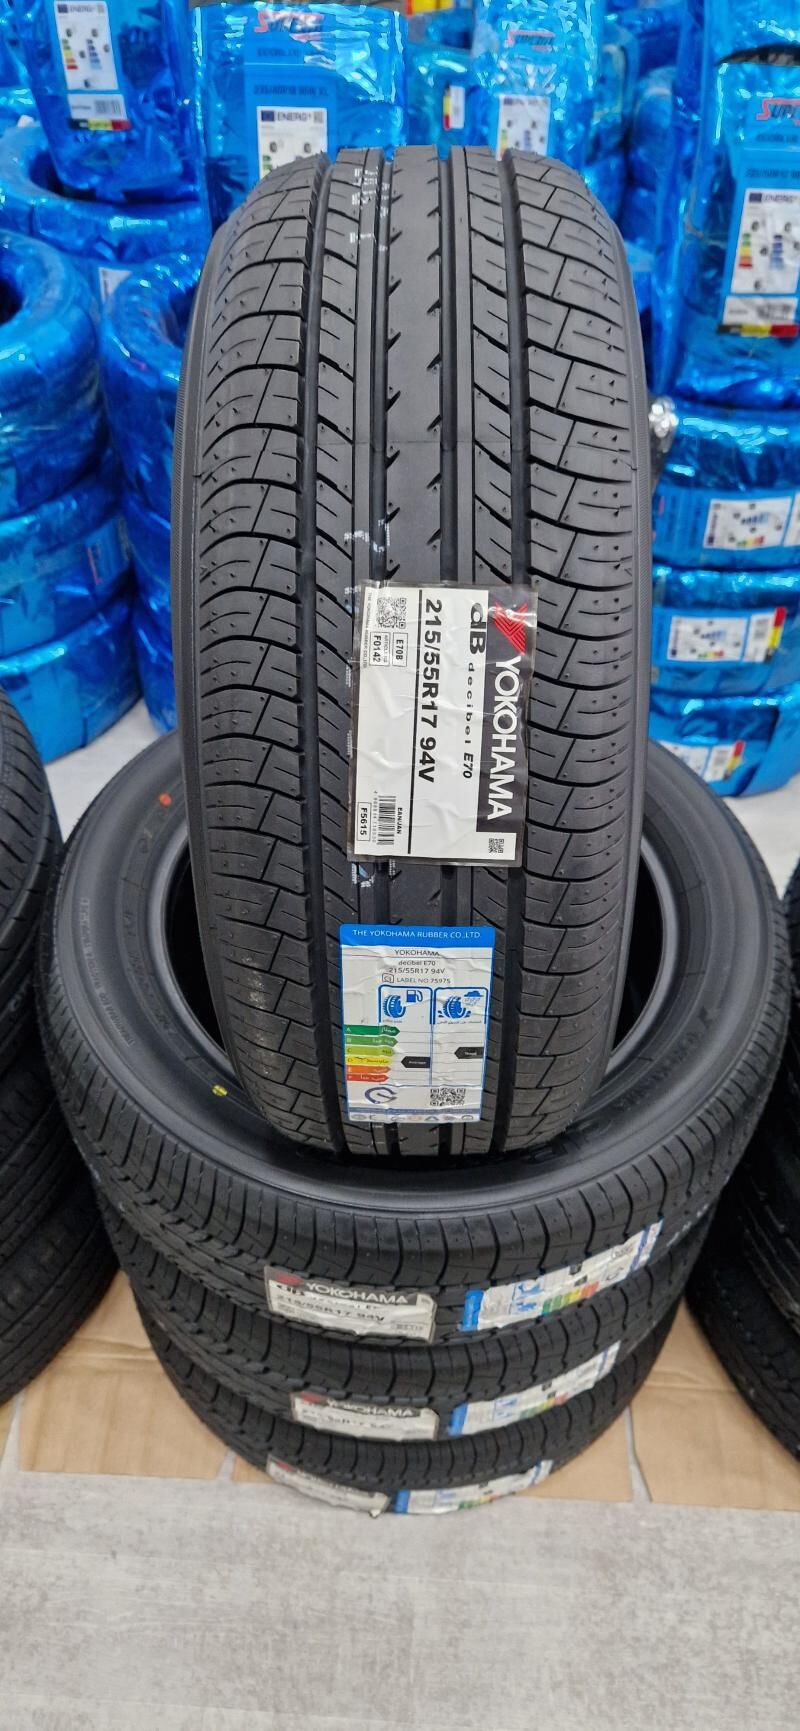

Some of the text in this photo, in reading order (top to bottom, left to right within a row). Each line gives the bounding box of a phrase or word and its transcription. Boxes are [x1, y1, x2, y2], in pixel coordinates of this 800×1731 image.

[372, 635, 381, 663] F0142
[418, 599, 442, 783] 215/55R17 94V
[463, 602, 487, 778] dB decibel E70
[487, 655, 521, 820] YOKOHAMA
[306, 1283, 408, 1304] YOKOHAMA
